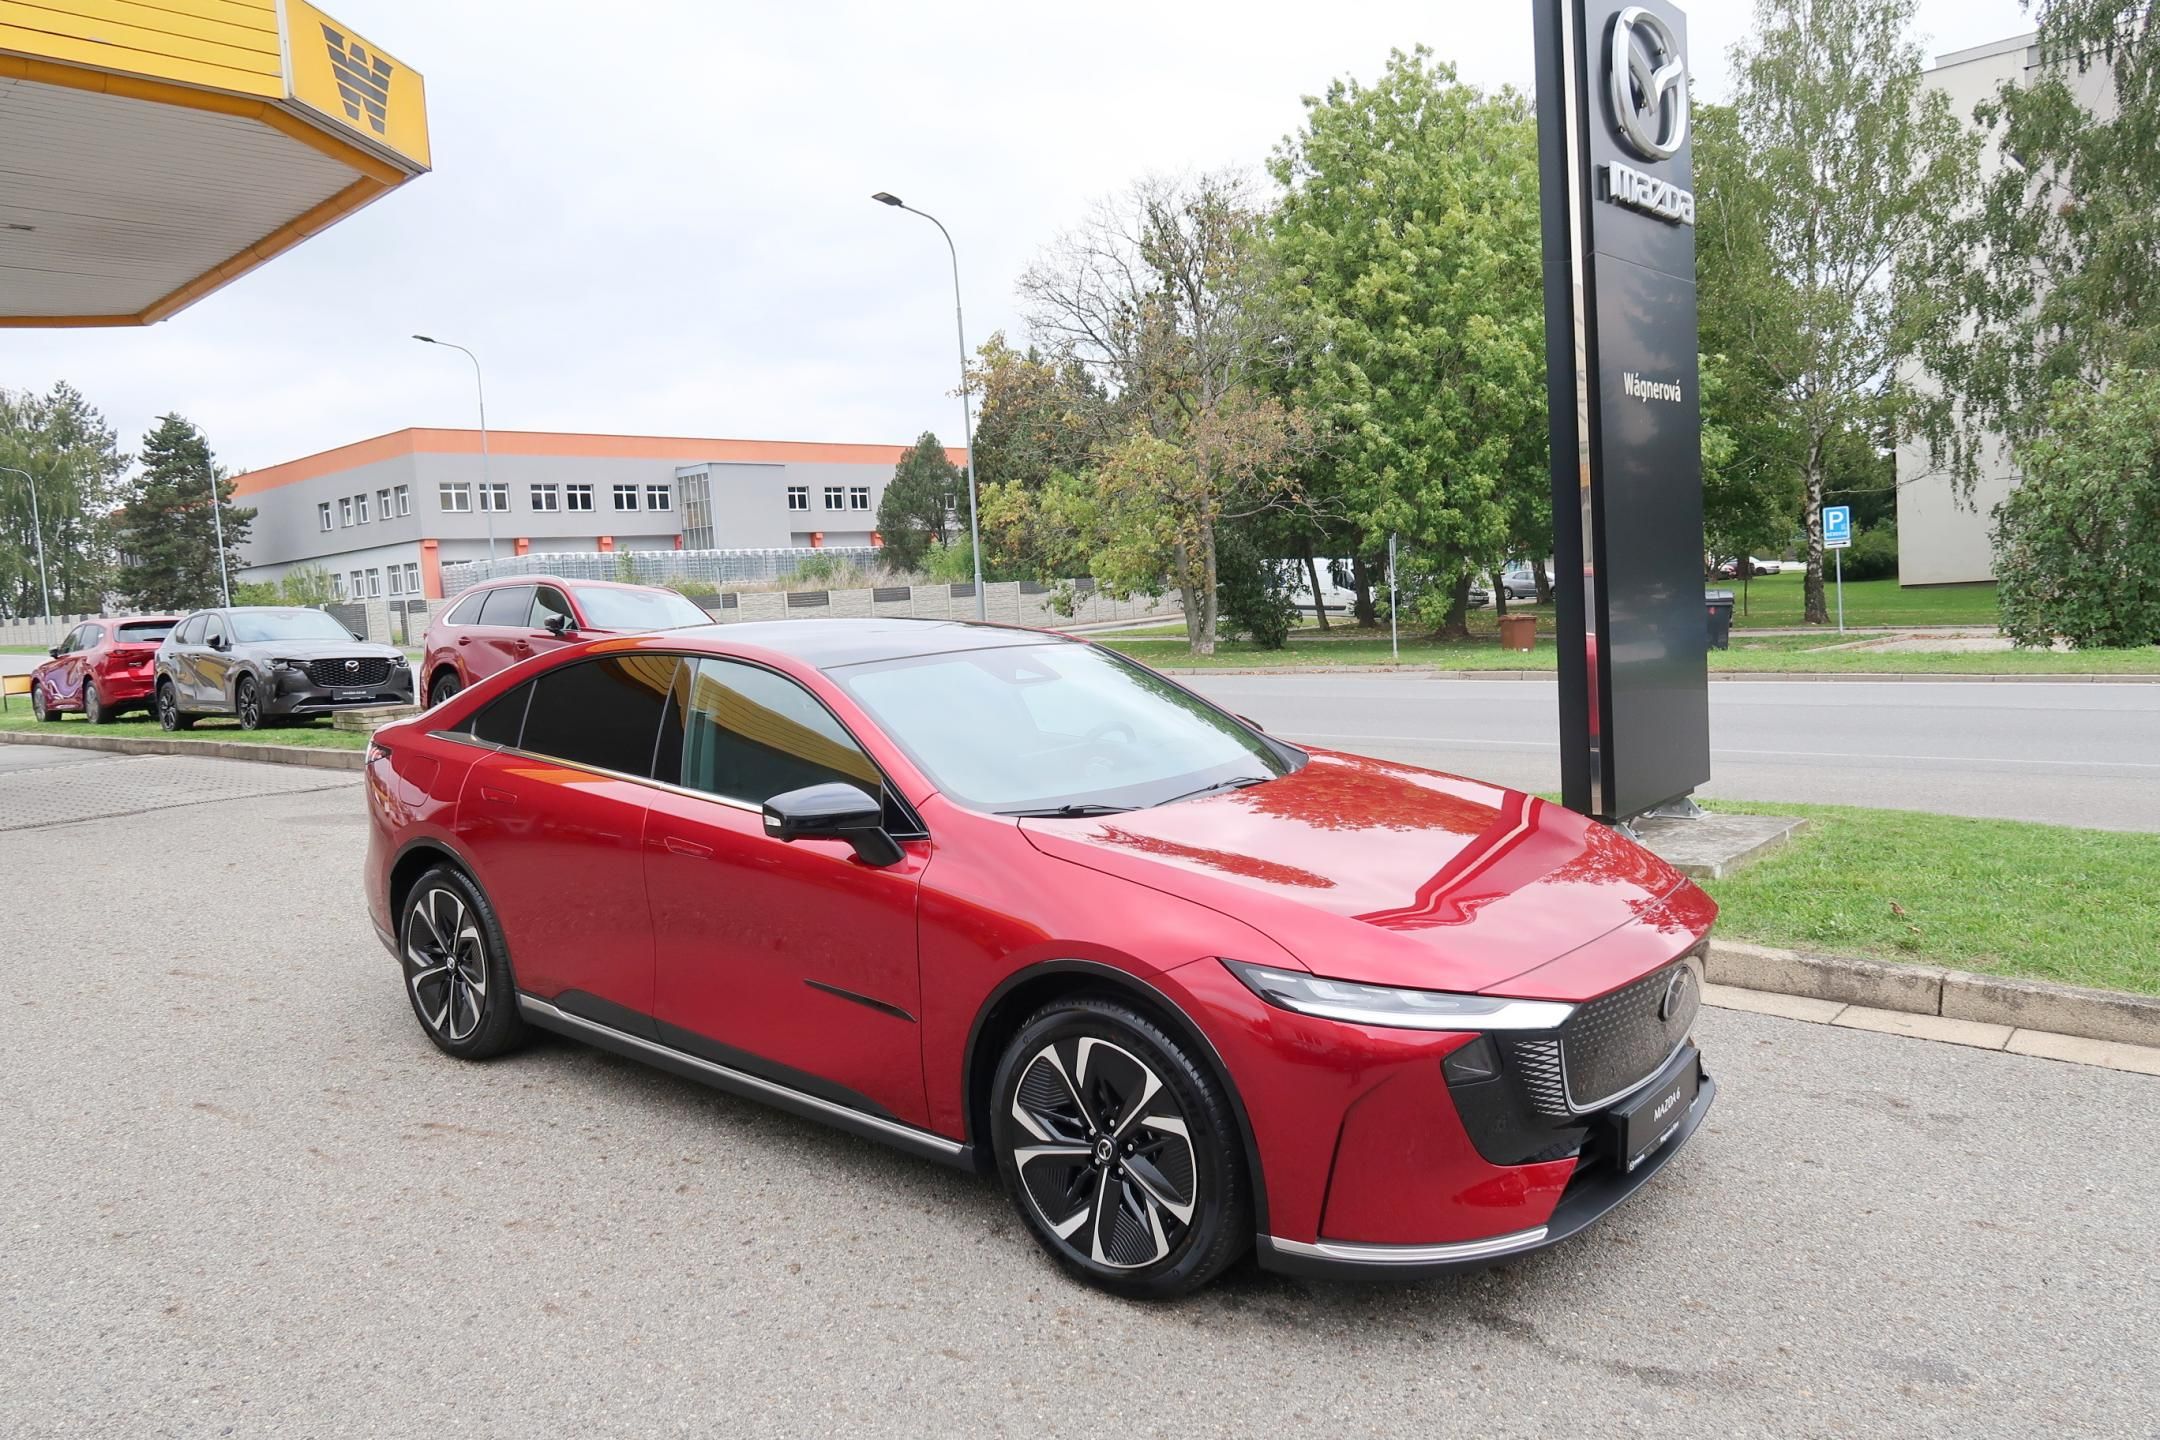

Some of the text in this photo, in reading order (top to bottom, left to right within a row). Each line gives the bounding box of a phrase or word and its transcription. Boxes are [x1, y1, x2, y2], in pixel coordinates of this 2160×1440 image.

[1623, 371, 1682, 403] Wágnerová
[1829, 511, 1844, 530] P
[1653, 1091, 1677, 1122] MAZDA
